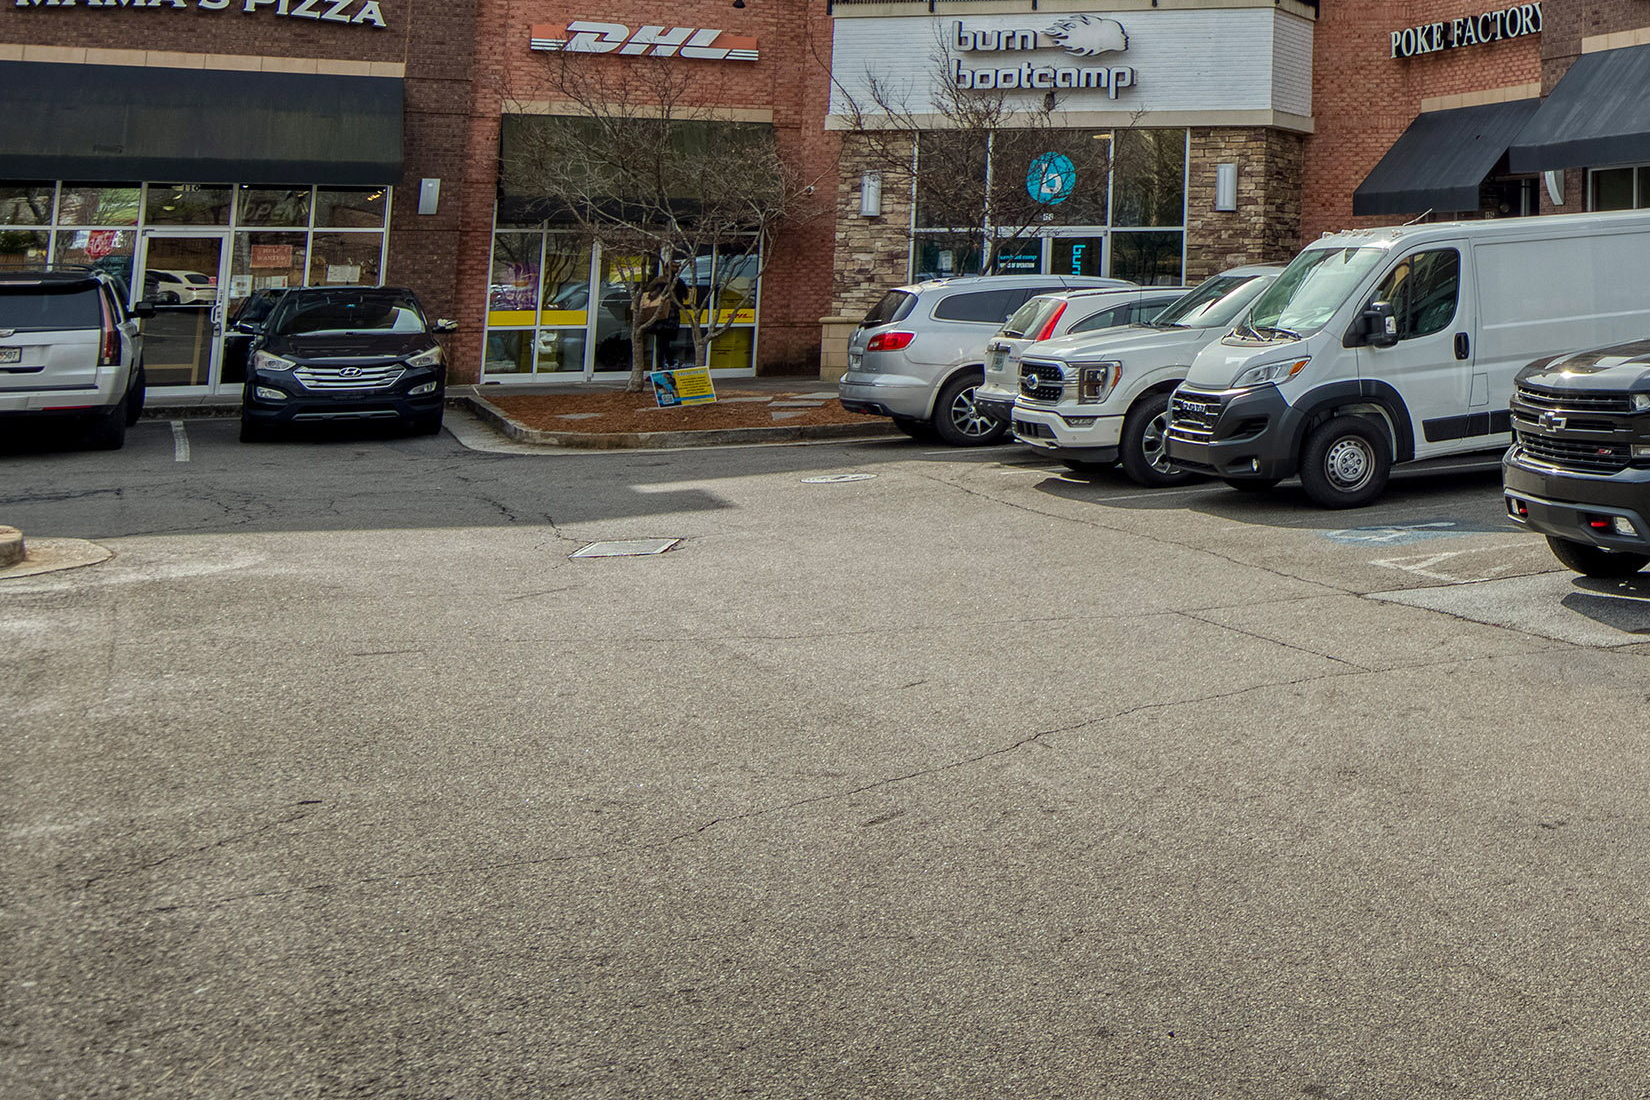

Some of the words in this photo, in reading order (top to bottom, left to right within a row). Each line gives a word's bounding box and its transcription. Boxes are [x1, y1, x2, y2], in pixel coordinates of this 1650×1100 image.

[562, 20, 731, 60] DHL
[952, 20, 1038, 51] burn
[1390, 21, 1444, 59] POKE
[1452, 1, 1543, 48] FACTORY
[951, 58, 1135, 100] bootcamp
